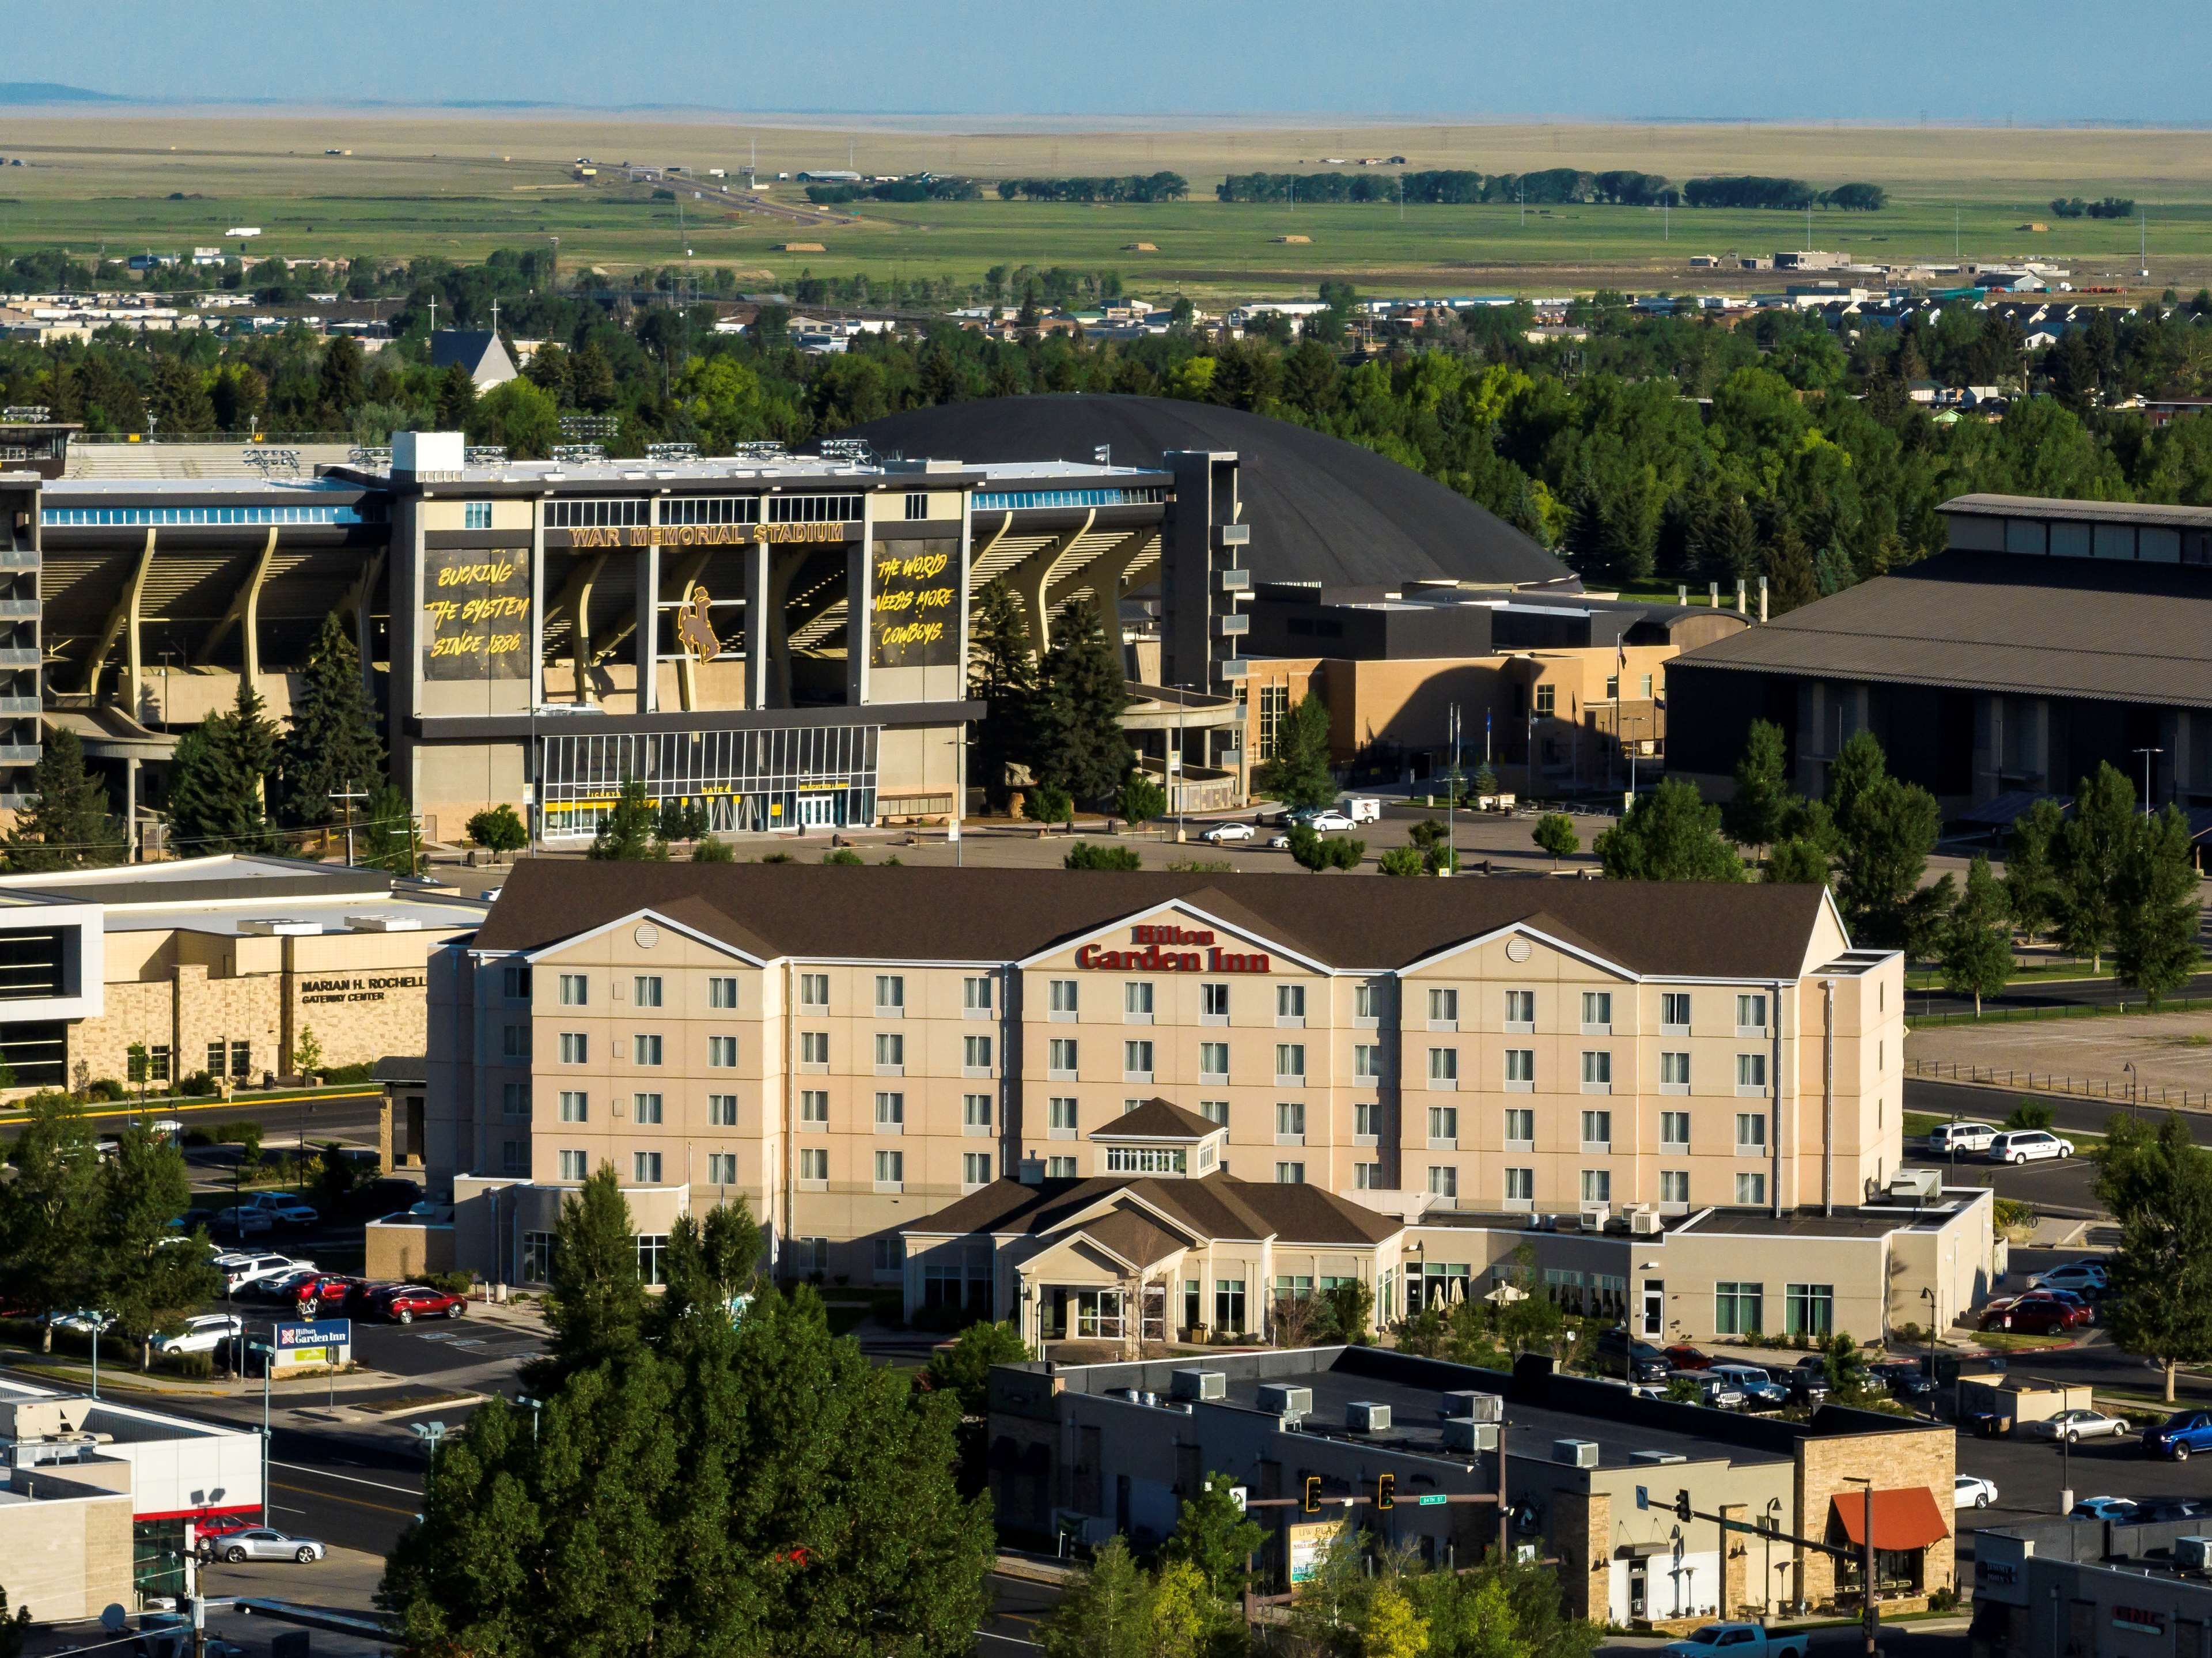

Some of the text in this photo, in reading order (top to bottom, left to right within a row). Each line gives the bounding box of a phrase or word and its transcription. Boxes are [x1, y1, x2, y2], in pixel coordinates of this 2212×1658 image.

[569, 523, 844, 547] WAR MEMORIAL STADIUM
[438, 558, 512, 586] BUCKING
[878, 553, 948, 585] THE WORLD
[876, 588, 955, 612] NEEDS MORE
[424, 596, 529, 630] THE SYSTEM
[430, 630, 485, 657] SINCE
[881, 622, 944, 646] COWBOYS.
[725, 783, 731, 793] 4
[1131, 925, 1215, 946] Hilton
[1075, 944, 1271, 972] Garden Inn
[302, 976, 427, 992] MARIAN H. ROCHELL
[302, 991, 384, 1004] GATEWAY CENTER
[295, 1332, 346, 1344] Garden Inn
[1299, 1524, 1340, 1536] UW PLAZ
